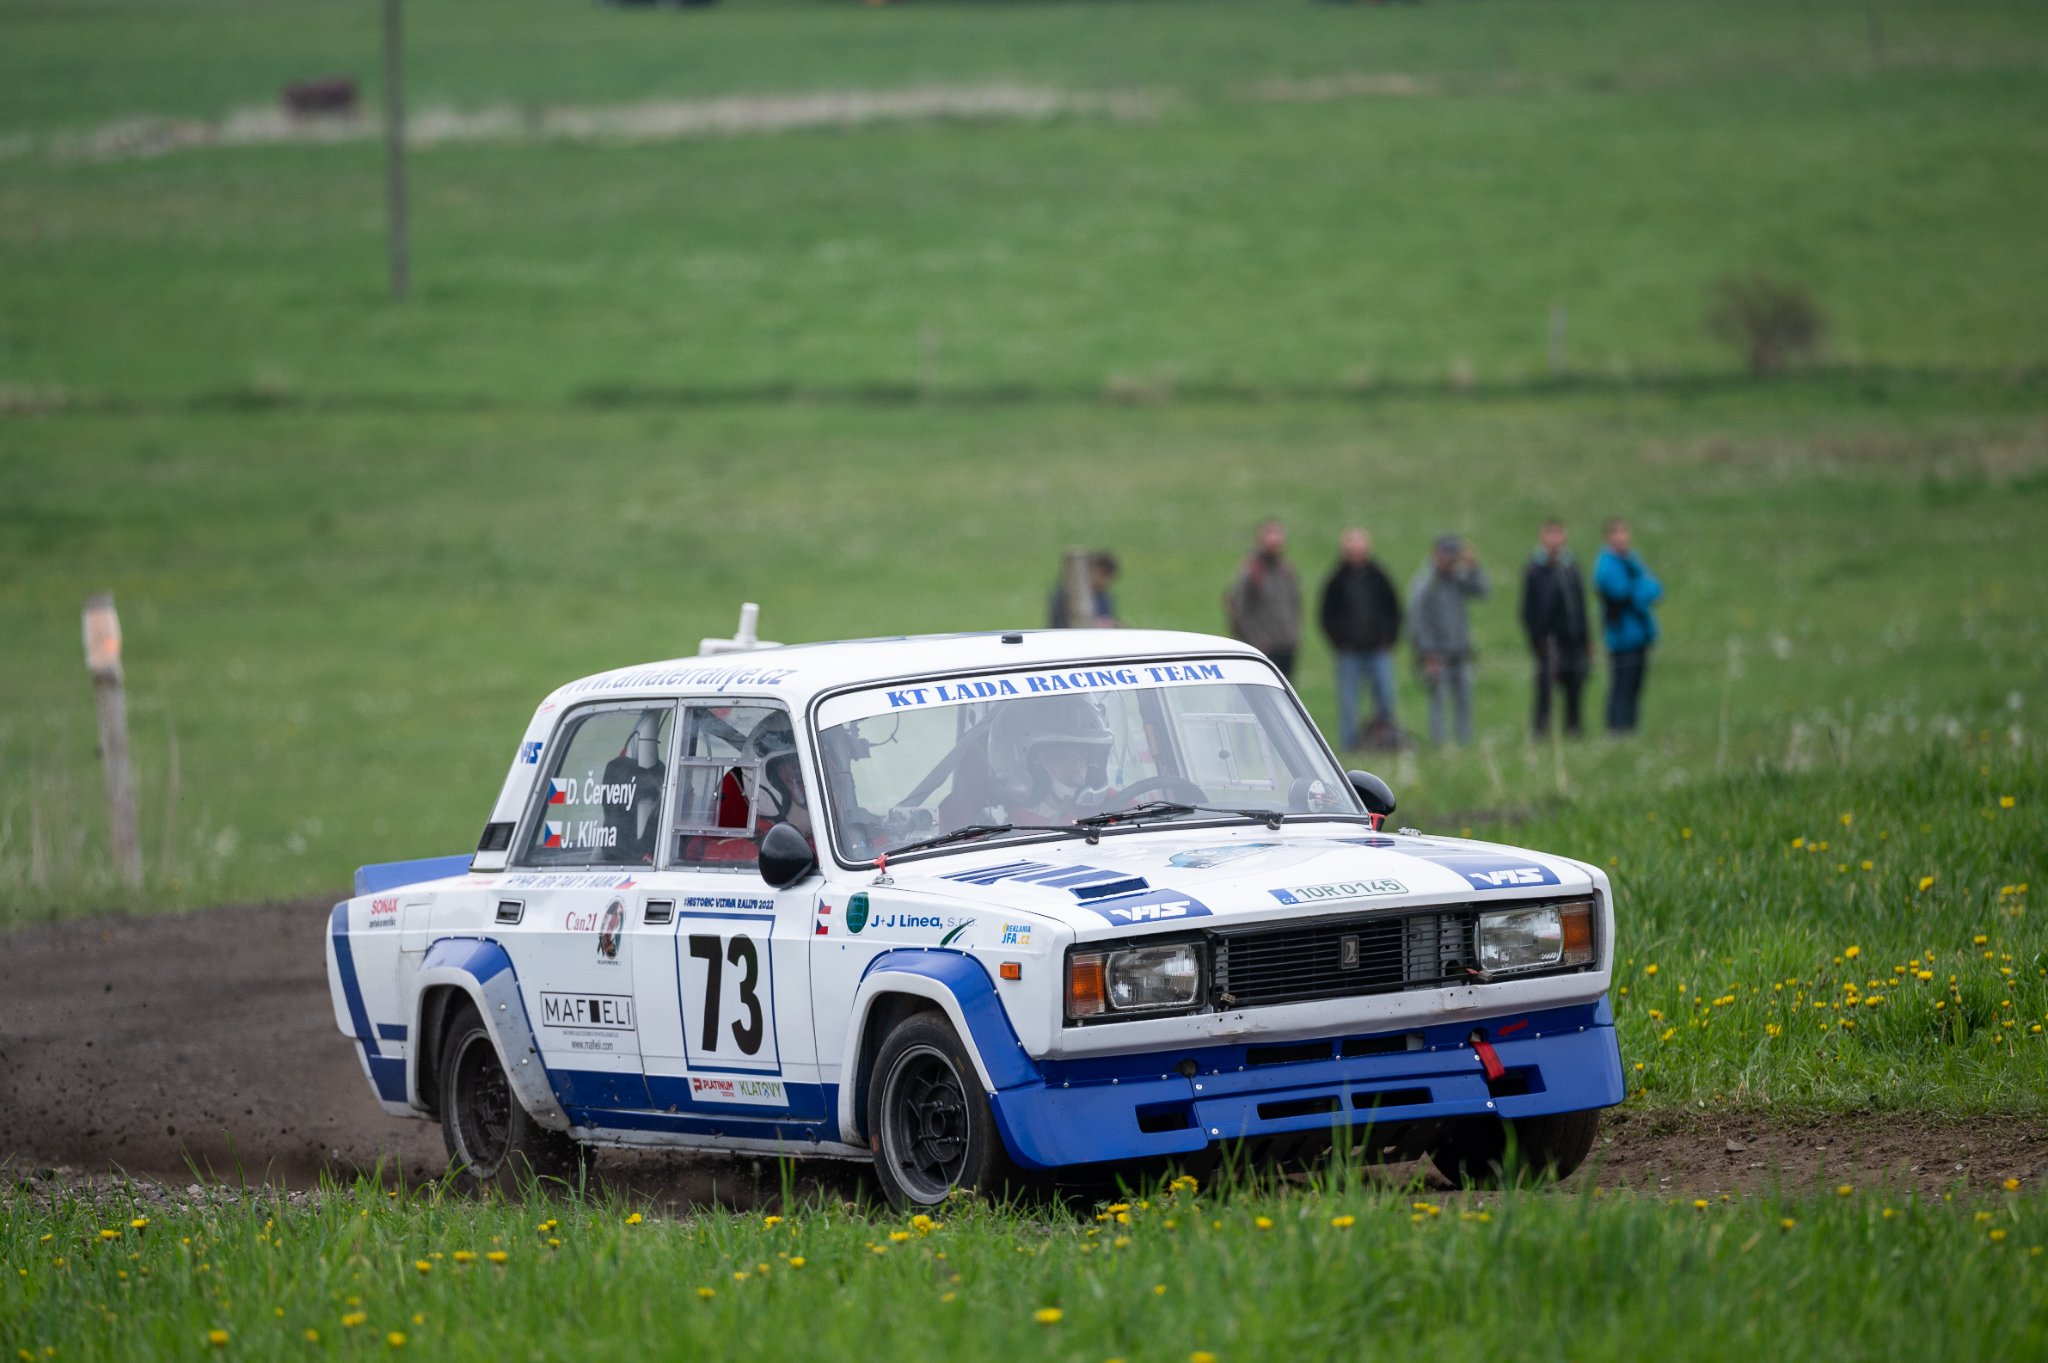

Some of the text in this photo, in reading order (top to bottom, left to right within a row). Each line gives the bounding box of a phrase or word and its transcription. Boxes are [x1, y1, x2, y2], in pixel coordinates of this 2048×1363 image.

[886, 663, 1226, 708] KT LADA RACING TEAM
[566, 770, 637, 812] D. Červený
[561, 820, 618, 849] J. Klíma
[371, 898, 399, 915] SONAX
[758, 899, 775, 910] 2022
[566, 911, 598, 932] Can21
[900, 914, 943, 930] Linea,
[689, 933, 764, 1056] 73
[702, 1079, 735, 1091] PLATINUM
[739, 1080, 782, 1098] KLATOVY
